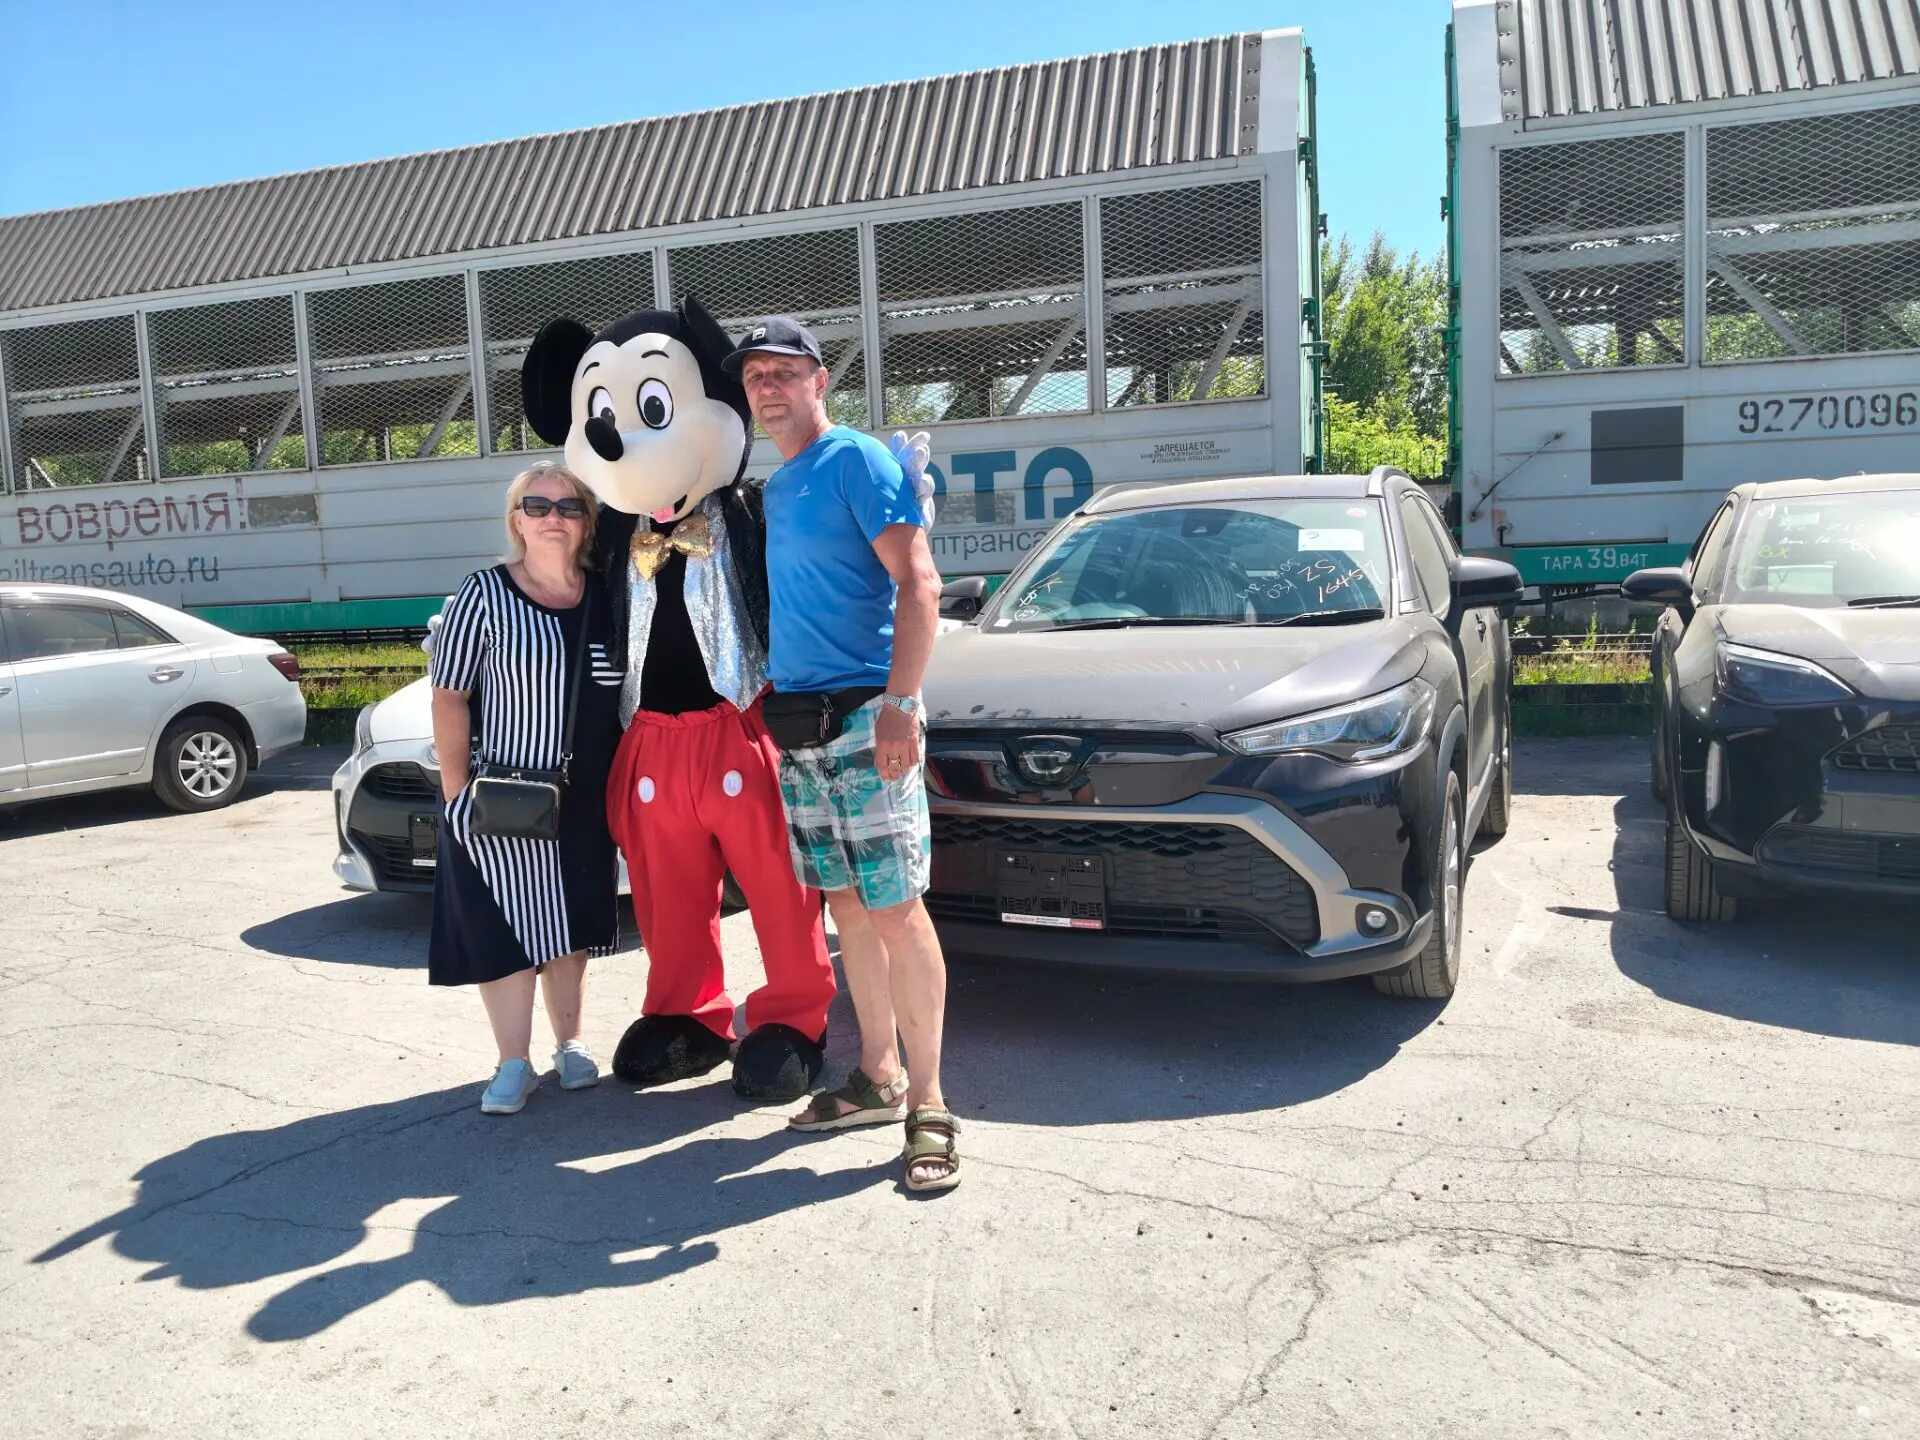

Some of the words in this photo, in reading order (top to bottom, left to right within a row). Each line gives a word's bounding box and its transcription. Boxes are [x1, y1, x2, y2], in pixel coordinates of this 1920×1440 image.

[1739, 393, 1917, 433] 9270096
[1153, 441, 1215, 453] ЗАПРЕЩАЕТСЯ
[16, 477, 248, 551] вовремя!
[1541, 556, 1583, 570] ТАРА
